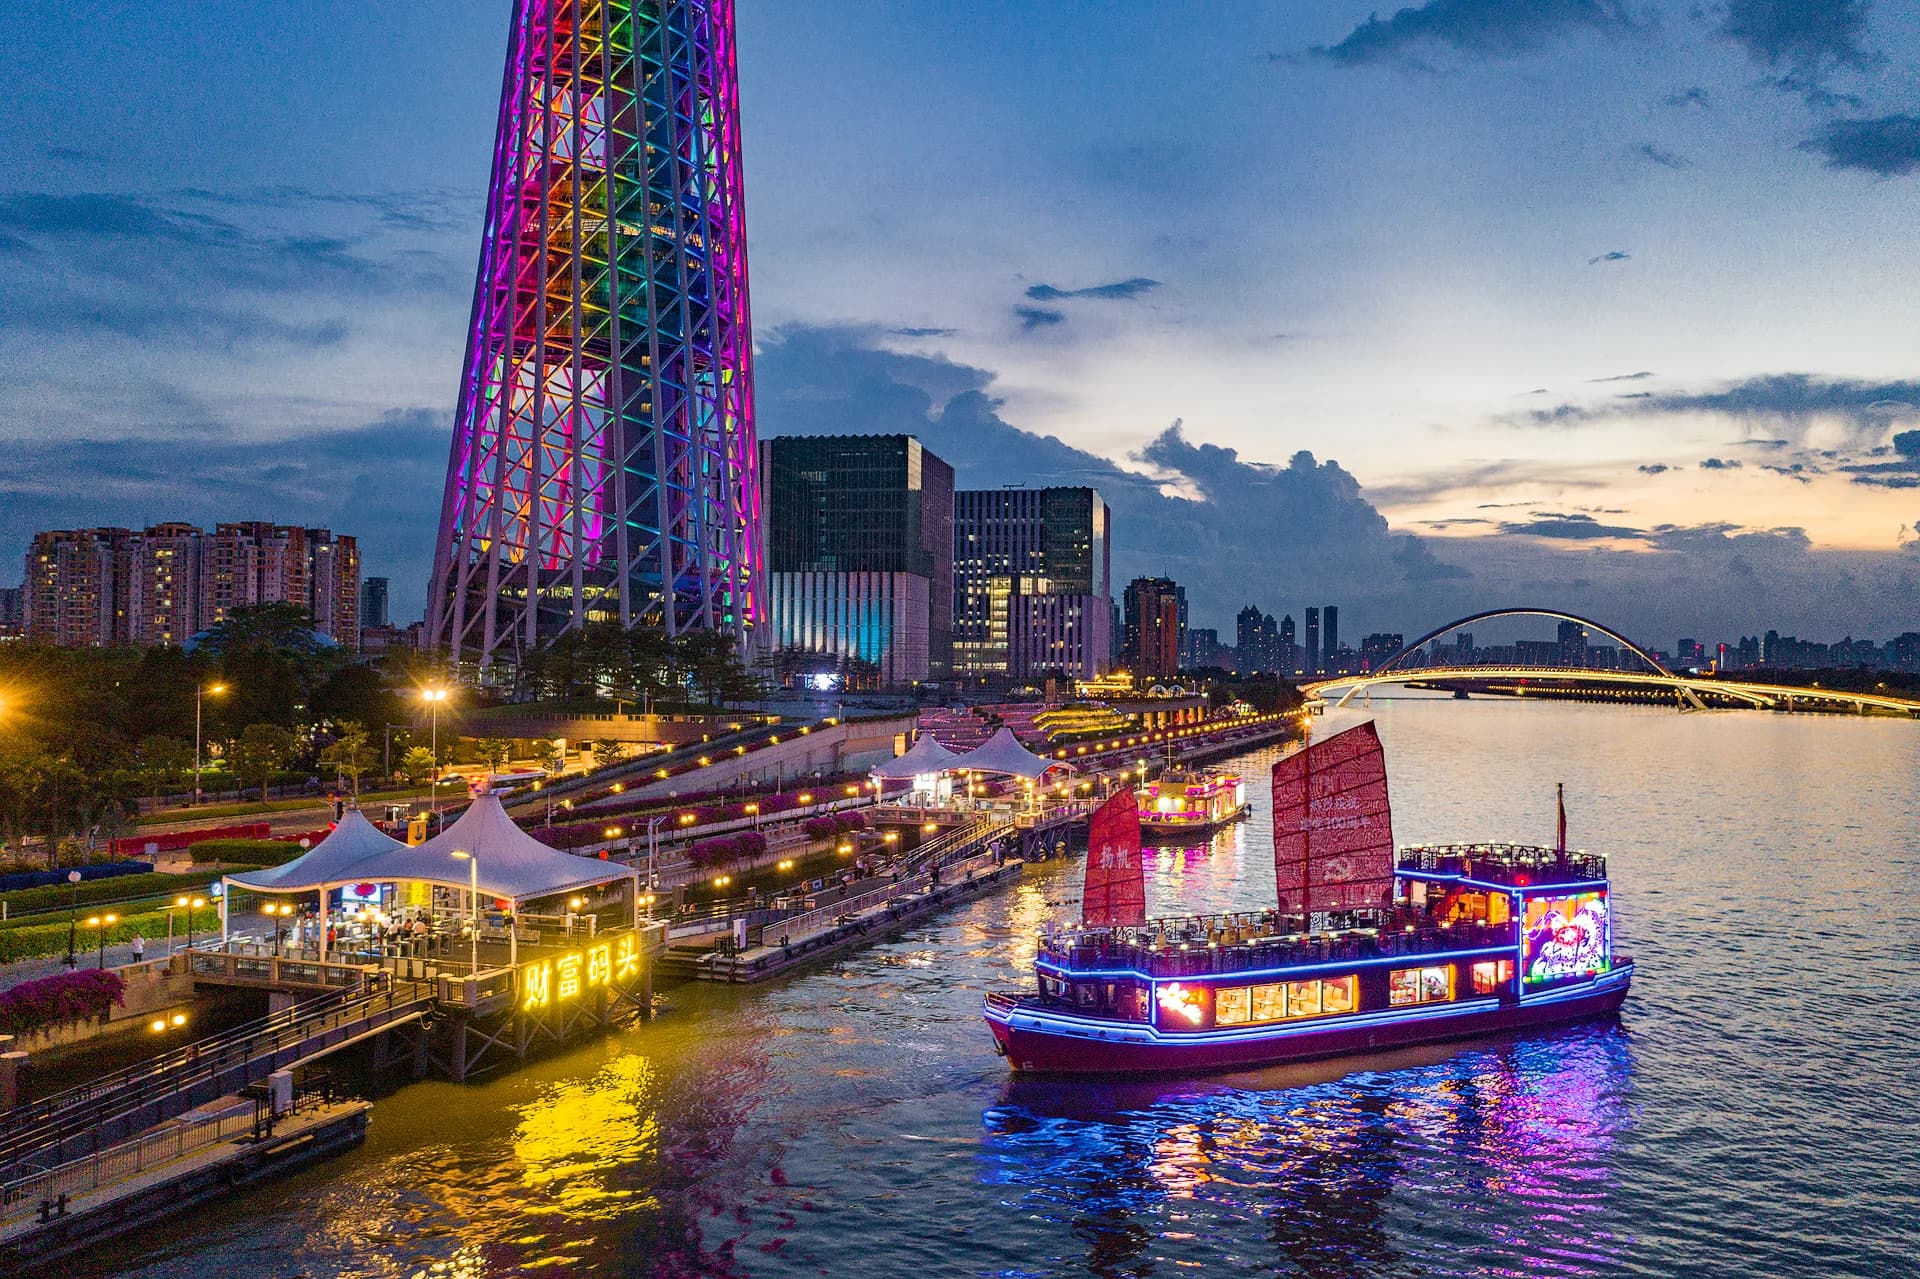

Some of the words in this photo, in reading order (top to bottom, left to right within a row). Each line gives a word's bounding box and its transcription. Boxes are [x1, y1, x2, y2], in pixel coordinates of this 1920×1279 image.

[1100, 845, 1131, 870] 扬帆
[524, 934, 639, 1010] 财富码头
